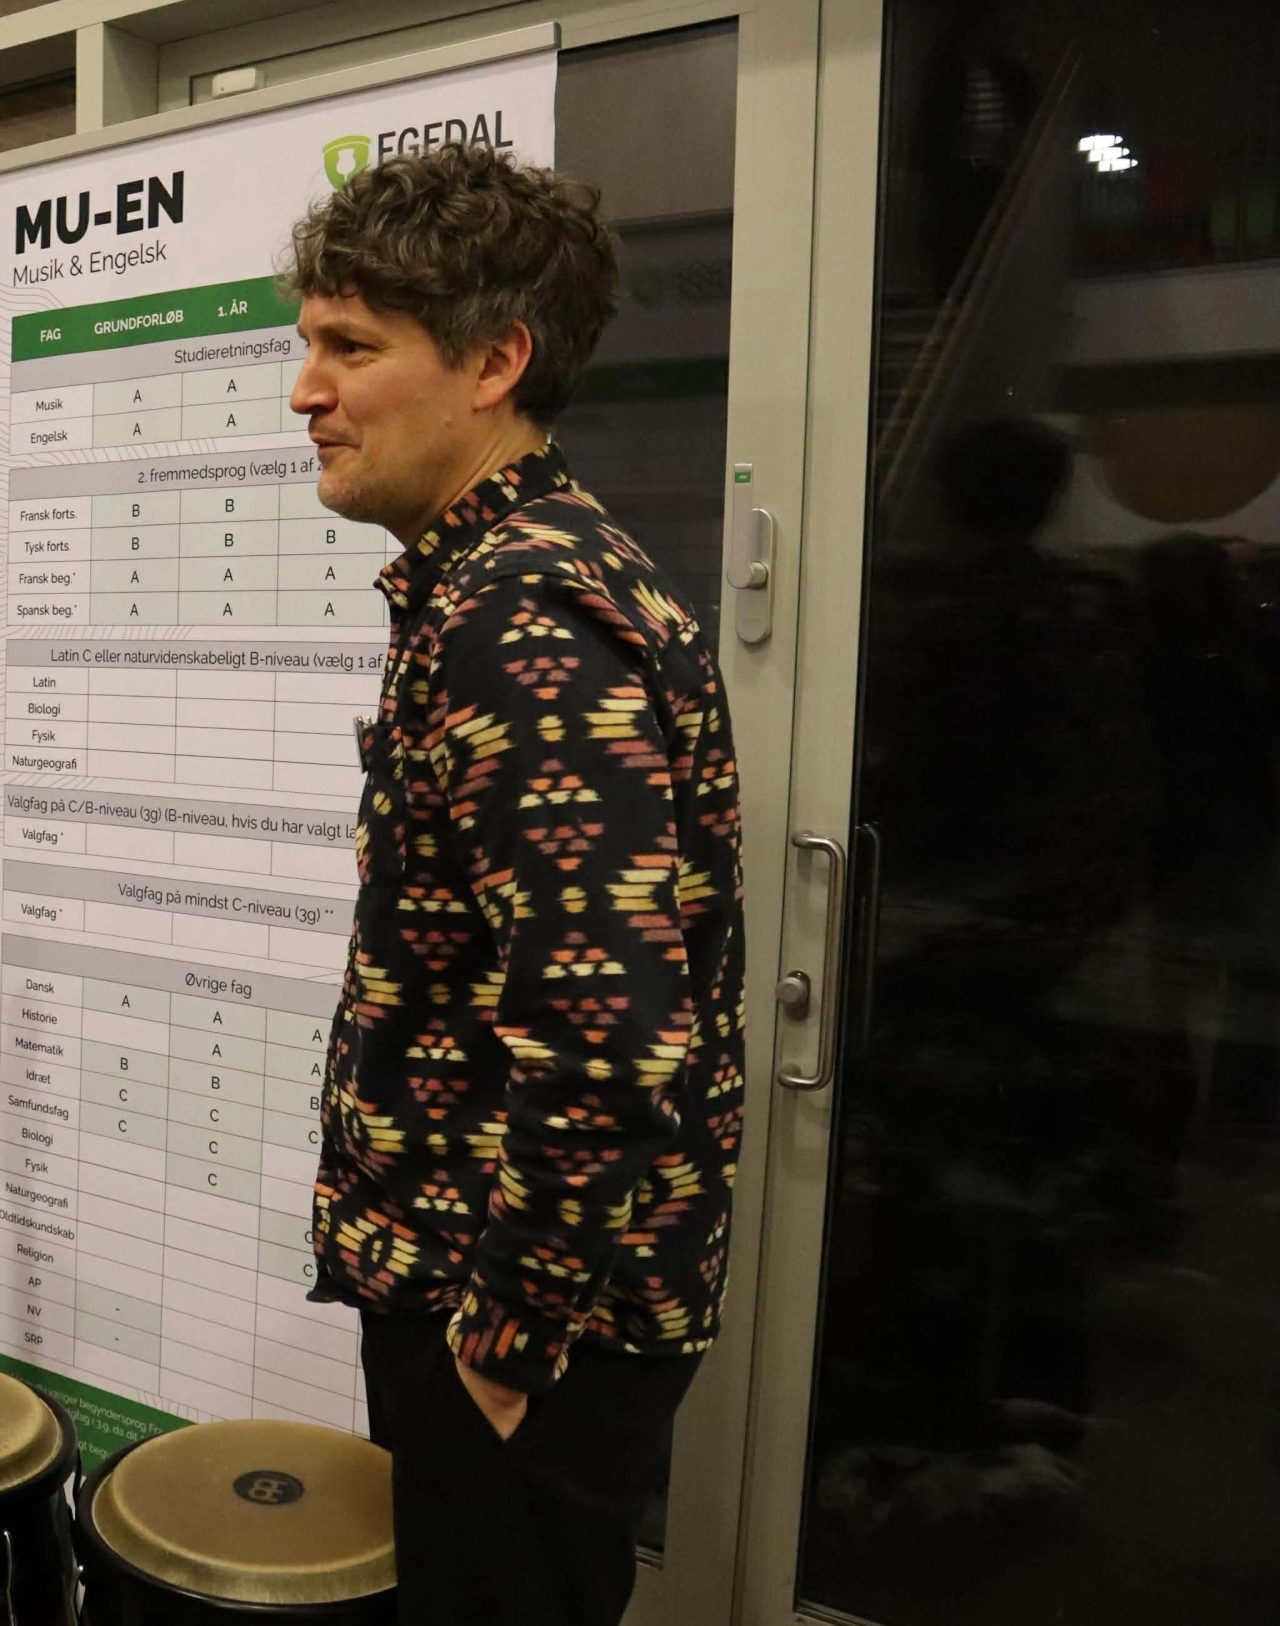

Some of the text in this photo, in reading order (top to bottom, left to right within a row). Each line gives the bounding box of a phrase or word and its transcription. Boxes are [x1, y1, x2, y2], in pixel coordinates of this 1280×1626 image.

[14, 171, 184, 255] MU-EN
[13, 241, 167, 286] Musik & Engelsk
[40, 300, 248, 342] FAG GRUNDFORLØB 1. ÅR
[174, 337, 291, 365] Studieretningsfag
[35, 379, 237, 413] Musik A A
[30, 413, 236, 447] Engelsk A A
[138, 459, 314, 484] 2. fremmedsprog (vælg 1 af
[20, 500, 234, 522] Fransk forts. B B
[24, 540, 71, 554] Tysk forts.
[19, 573, 49, 584] Fransk
[130, 572, 139, 583] A
[224, 569, 233, 581] A
[325, 567, 335, 580] A
[17, 605, 49, 619] Spansk
[51, 650, 383, 669] Latin C eller naturvidenskabeligt B-niveau (vælg 1 af
[33, 677, 56, 688] Latin
[28, 703, 61, 718] Biologi
[32, 730, 55, 743] Fysik
[12, 756, 77, 771] Naturgeografi
[8, 796, 48, 814] Valgfag
[51, 799, 65, 813] på
[68, 801, 137, 818] C/B-niveau
[140, 807, 162, 822] (3g)
[165, 808, 228, 828] (B-niveau,
[232, 815, 258, 830] hvis
[261, 816, 278, 832] du
[281, 821, 303, 834] har
[307, 822, 341, 840] valgt
[22, 828, 58, 844] Valgfag
[21, 904, 57, 921] Valgfag
[118, 883, 320, 925] Valgfag på mindst C-niveau (3g)
[185, 972, 252, 998] Øvrige fag
[22, 1009, 57, 1025] Historie
[26, 979, 322, 1042] Dansk A A A
[15, 1037, 319, 1110] Matematik B B B
[8, 1094, 69, 1120] Samfundsfag
[26, 1069, 318, 1144] Idræt C C C
[22, 1128, 217, 1187] Biologi C
[25, 1158, 48, 1173] Fysik
[5, 1182, 68, 1209] Naturgeografi
[0, 1209, 313, 1278] Oldtidskundskab C
[17, 1243, 54, 1263] Religion
[28, 1276, 41, 1288] AP
[27, 1304, 41, 1317] NV
[24, 1332, 43, 1346] SRP
